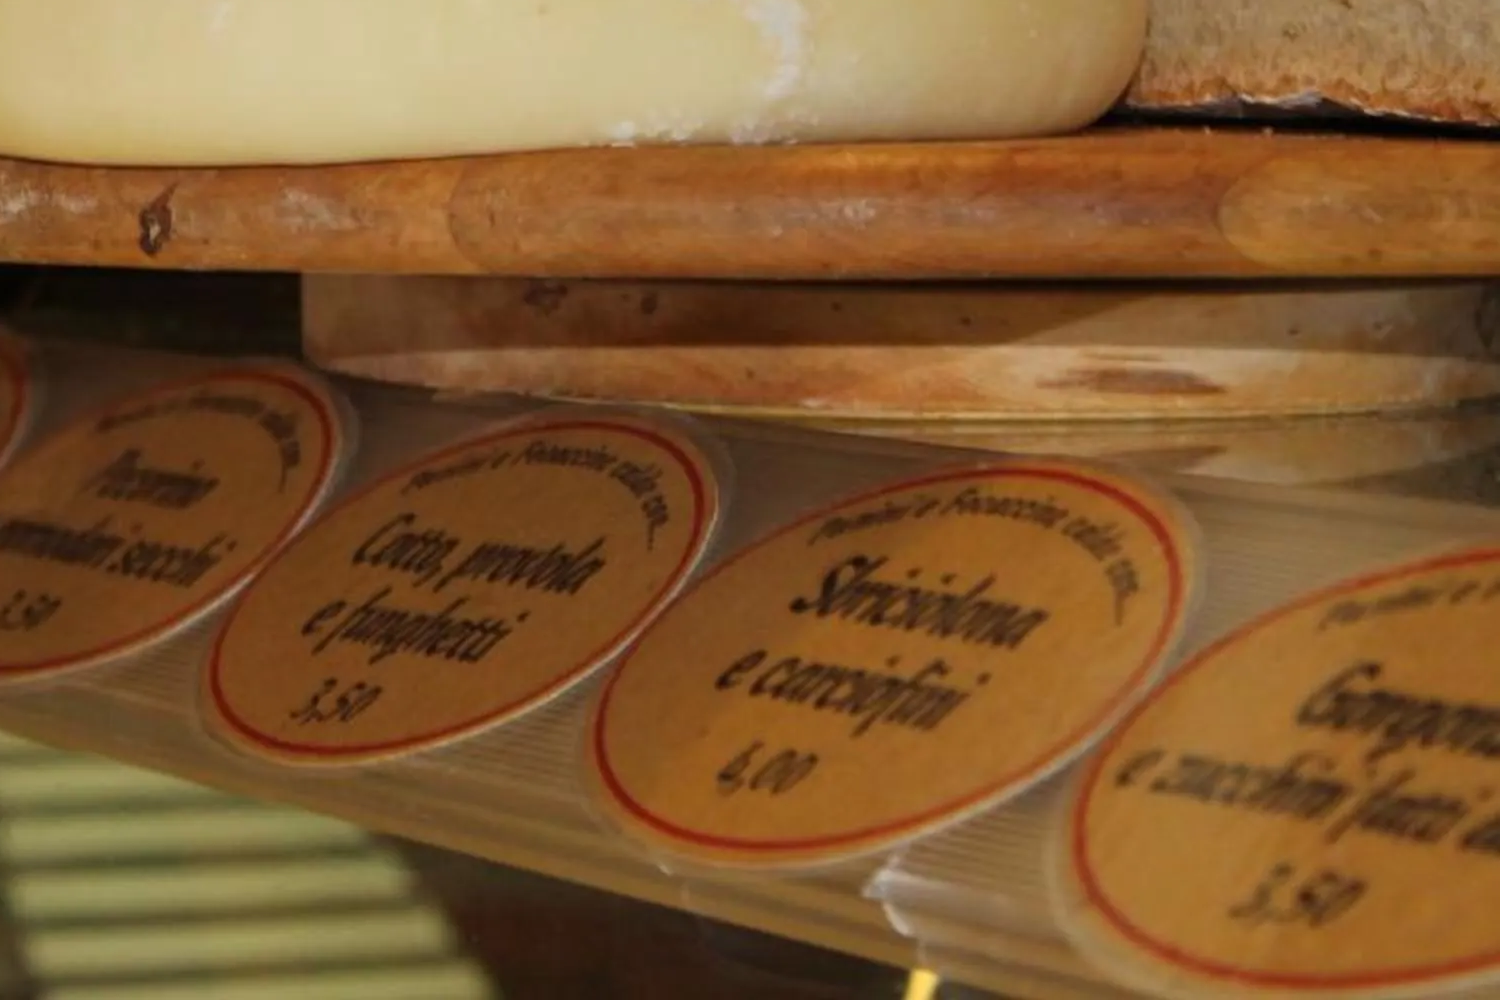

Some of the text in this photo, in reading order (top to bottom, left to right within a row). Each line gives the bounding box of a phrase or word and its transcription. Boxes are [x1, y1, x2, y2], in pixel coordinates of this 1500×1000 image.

[432, 536, 607, 596] provola
[789, 553, 1052, 651] Sbriciolona
[300, 586, 531, 665] e funghetti
[714, 647, 992, 738] e carciofini
